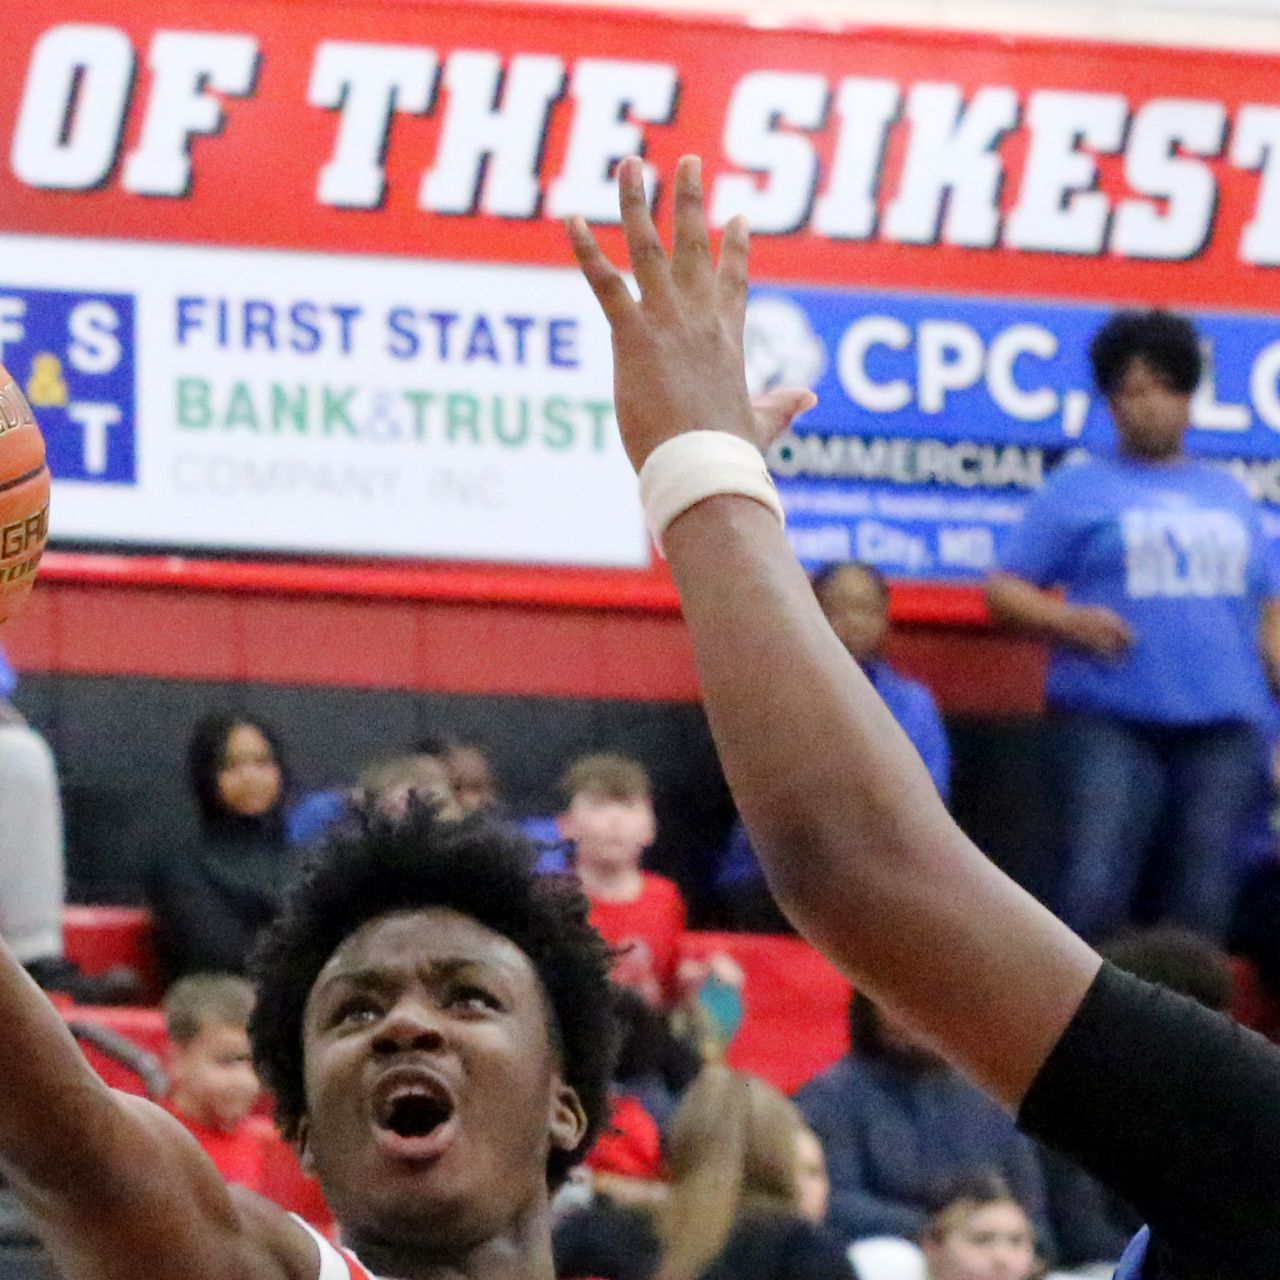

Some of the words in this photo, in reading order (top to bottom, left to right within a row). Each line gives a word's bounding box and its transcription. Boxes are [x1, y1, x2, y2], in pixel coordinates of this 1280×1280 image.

[10, 22, 263, 198] OF
[306, 40, 680, 225] THE
[66, 304, 122, 374] S
[173, 296, 363, 353] FIRST
[386, 306, 582, 368] STATE
[836, 315, 1088, 438] CPC,
[71, 406, 121, 474] T
[768, 432, 1045, 489] OMMERCIAL
